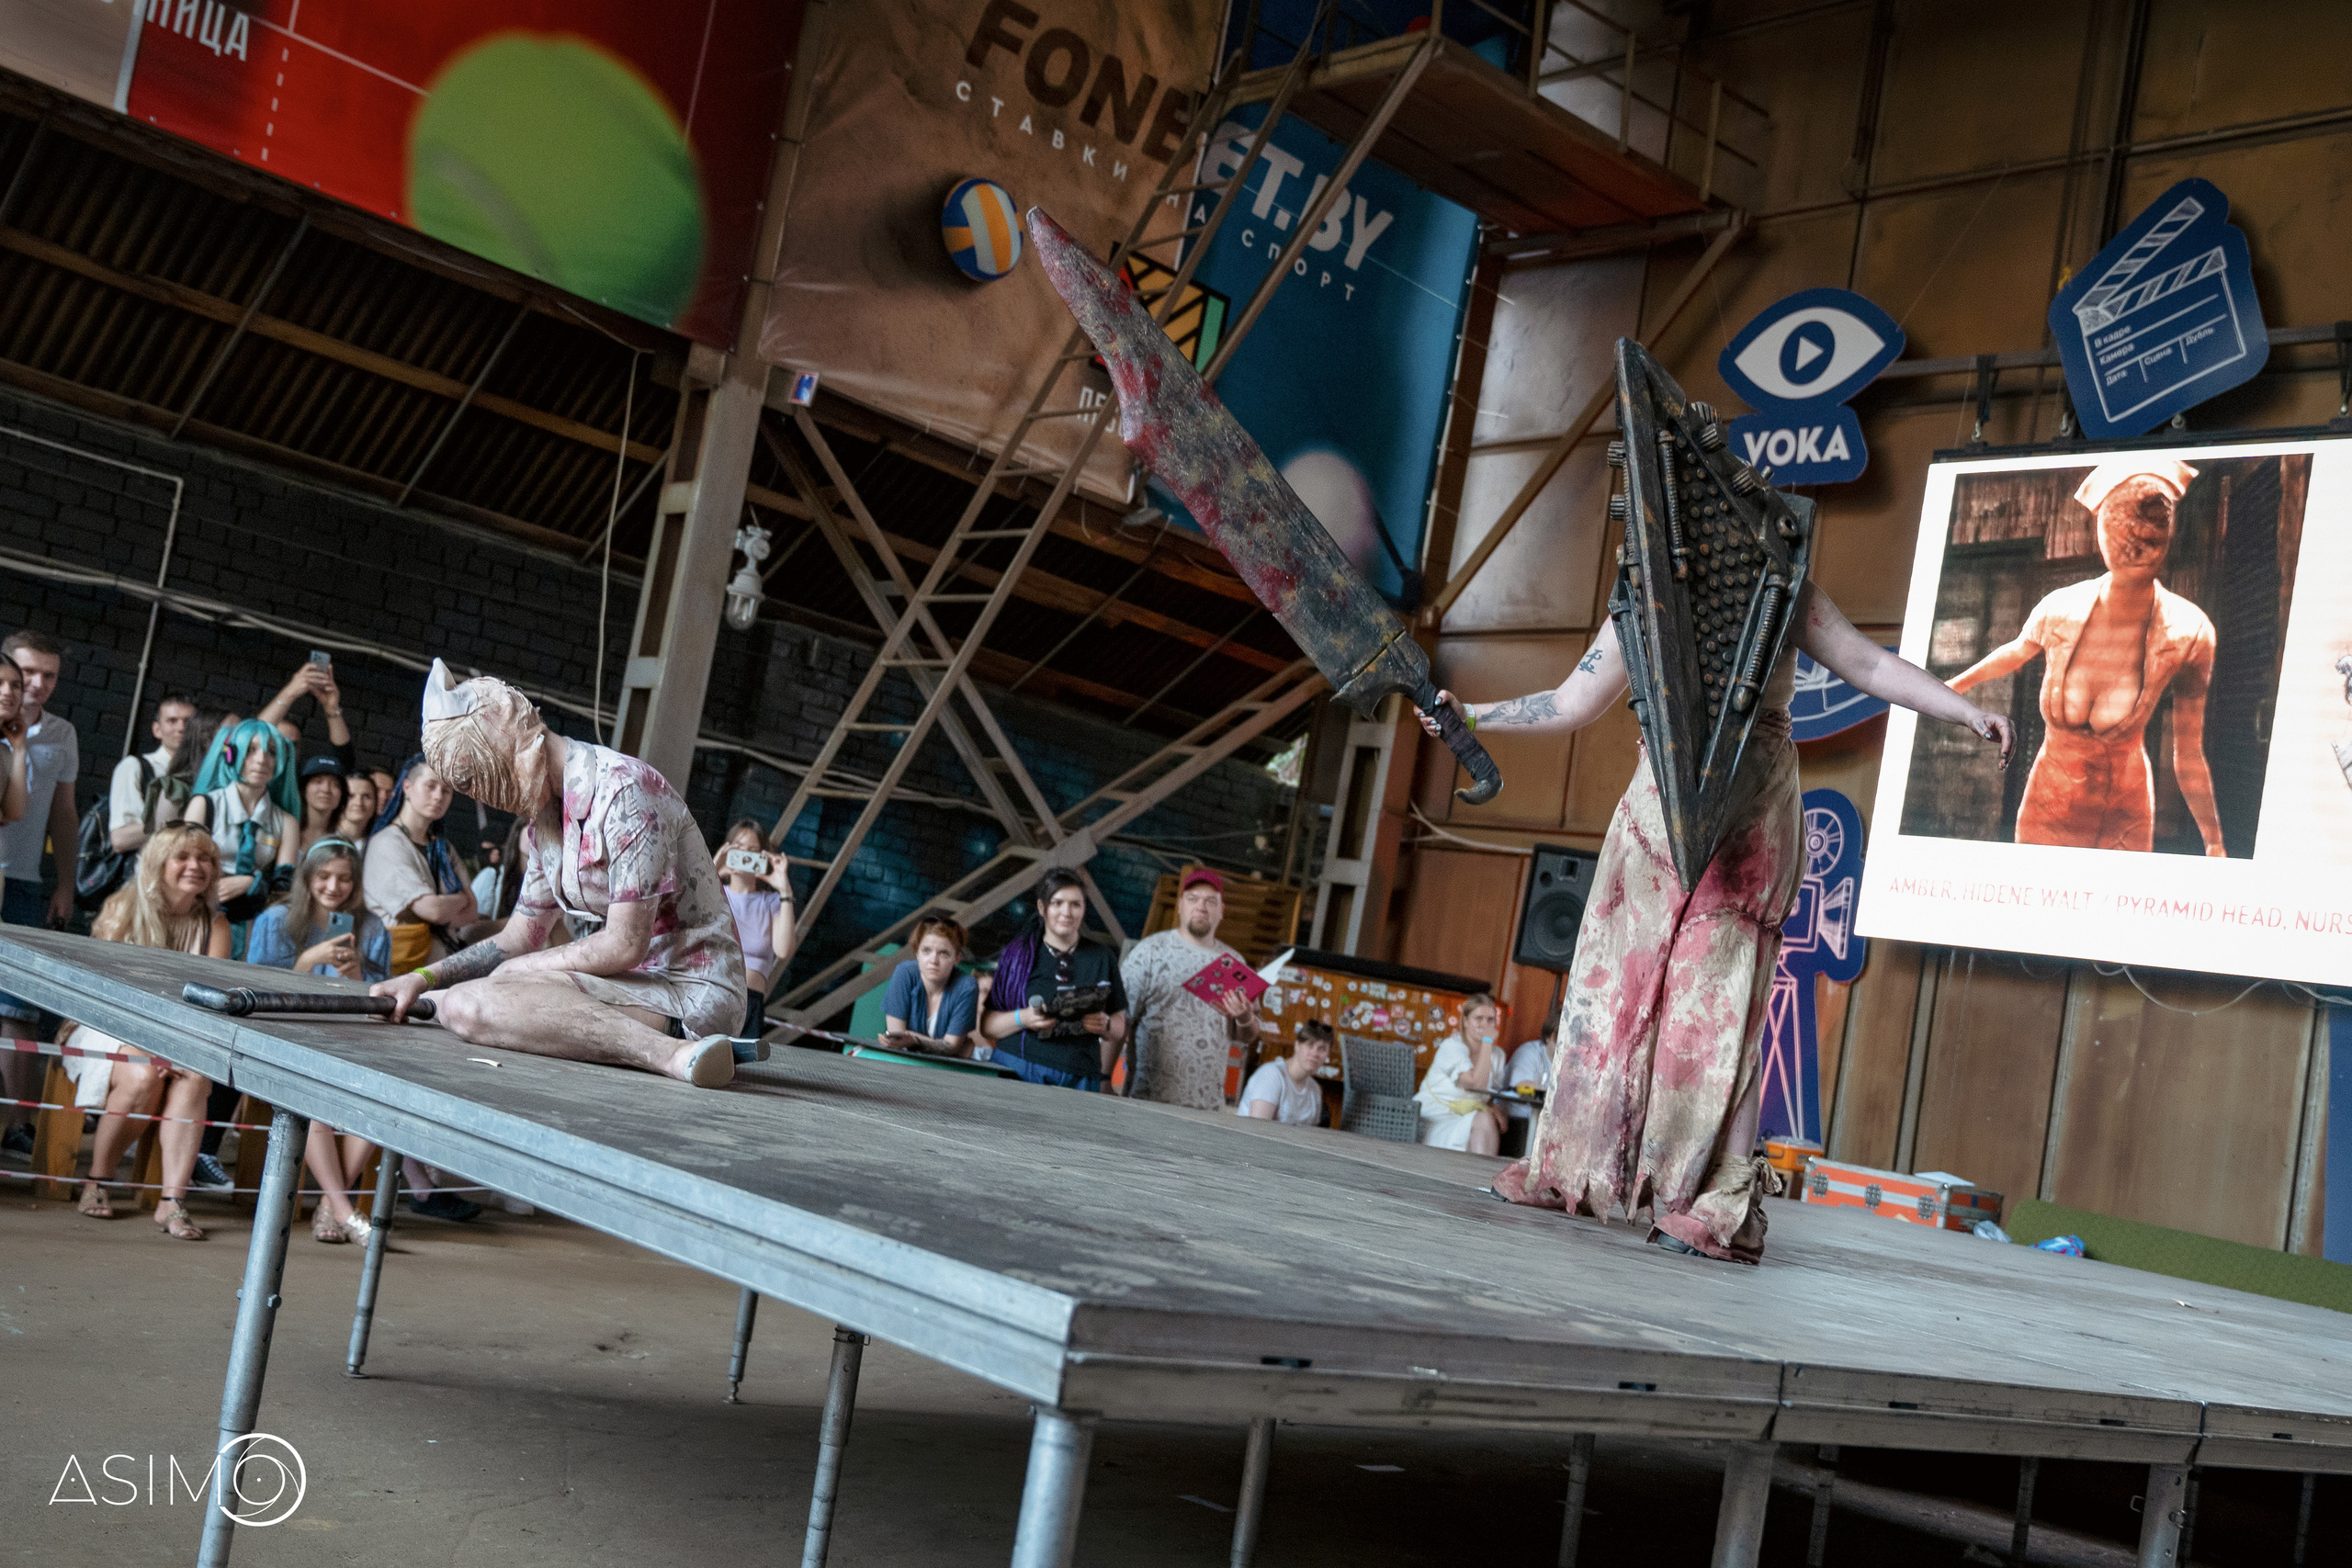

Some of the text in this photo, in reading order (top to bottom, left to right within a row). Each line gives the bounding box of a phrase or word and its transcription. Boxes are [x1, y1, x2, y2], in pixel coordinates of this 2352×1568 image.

[956, 81, 1128, 182] СТАВКИ
[1241, 229, 1355, 301] СПОРТ
[2094, 324, 2132, 348] В кадре
[2099, 343, 2135, 366] Камера
[2106, 327, 2215, 387] Дата Сцена Дубль
[1743, 424, 1851, 467] VOKA
[1889, 877, 1957, 901] AMBER,
[1962, 883, 2034, 907] HIDENE
[2041, 888, 2094, 910] WALT
[2117, 895, 2213, 921] PYRAMID
[2222, 904, 2287, 931] HEAD,
